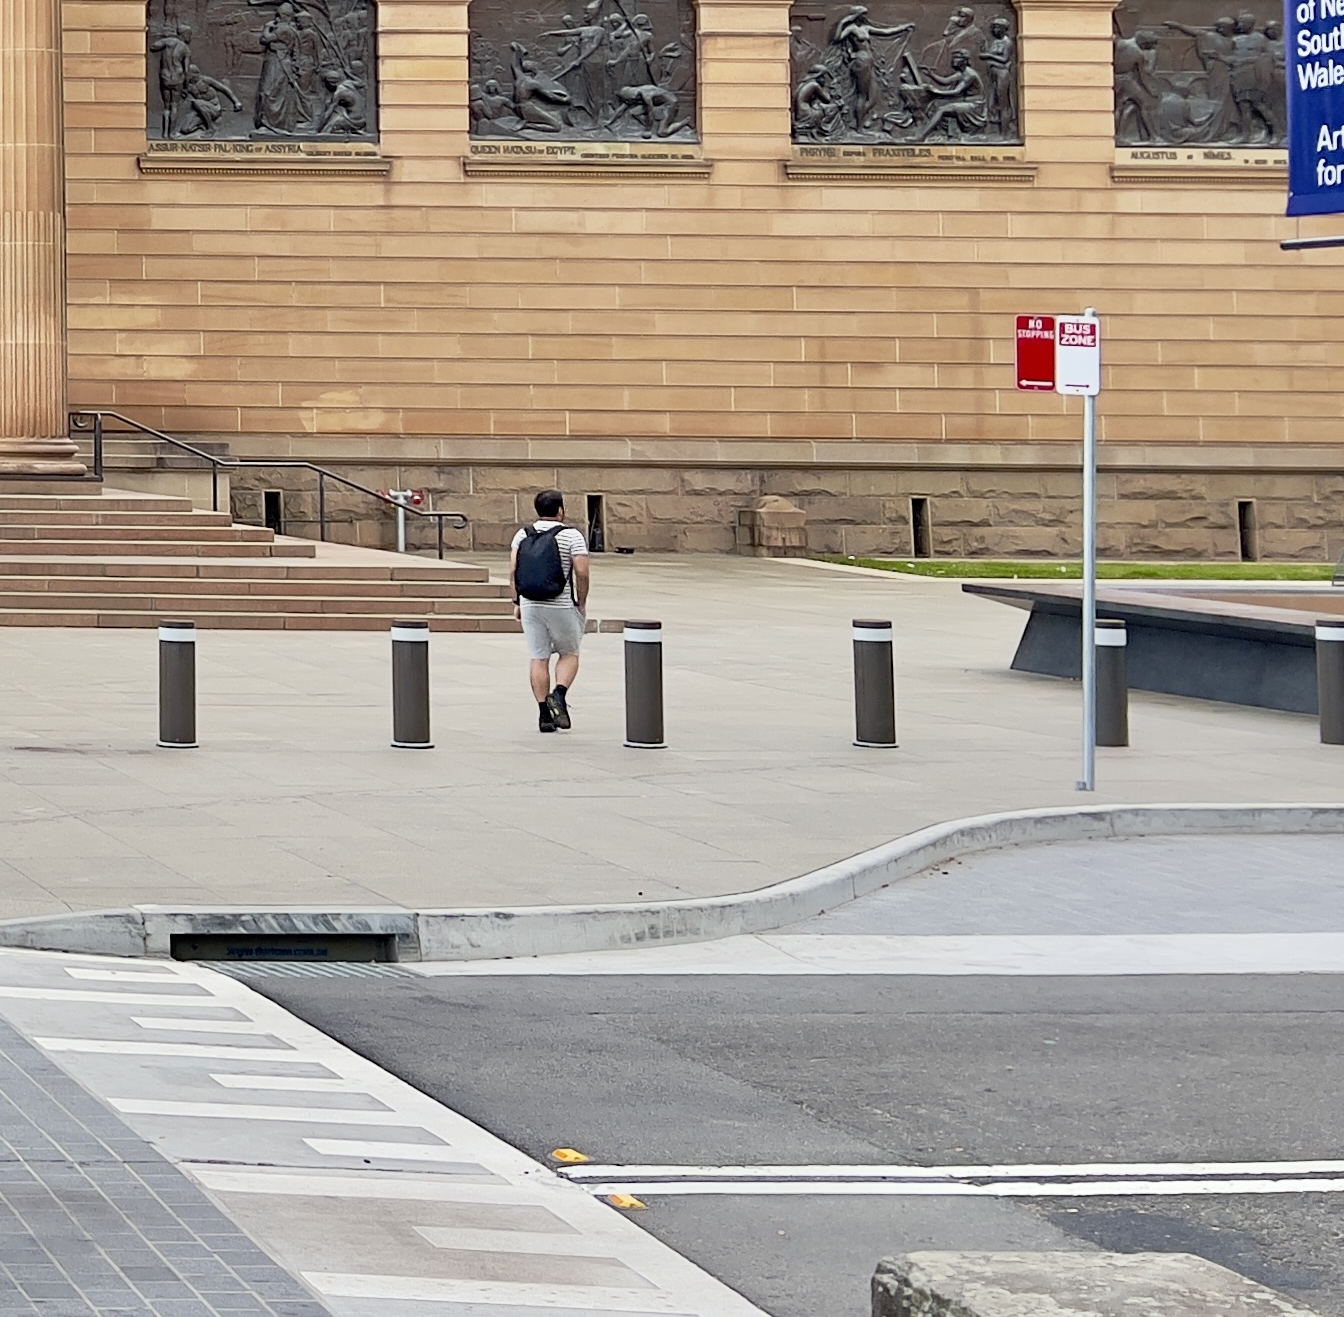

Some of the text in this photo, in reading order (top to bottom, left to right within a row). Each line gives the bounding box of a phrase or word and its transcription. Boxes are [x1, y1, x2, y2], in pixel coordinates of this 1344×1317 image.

[1028, 319, 1043, 329] NO
[1064, 323, 1091, 335] BUS
[1017, 329, 1054, 339] STOPPING
[1060, 333, 1095, 346] ZONE
